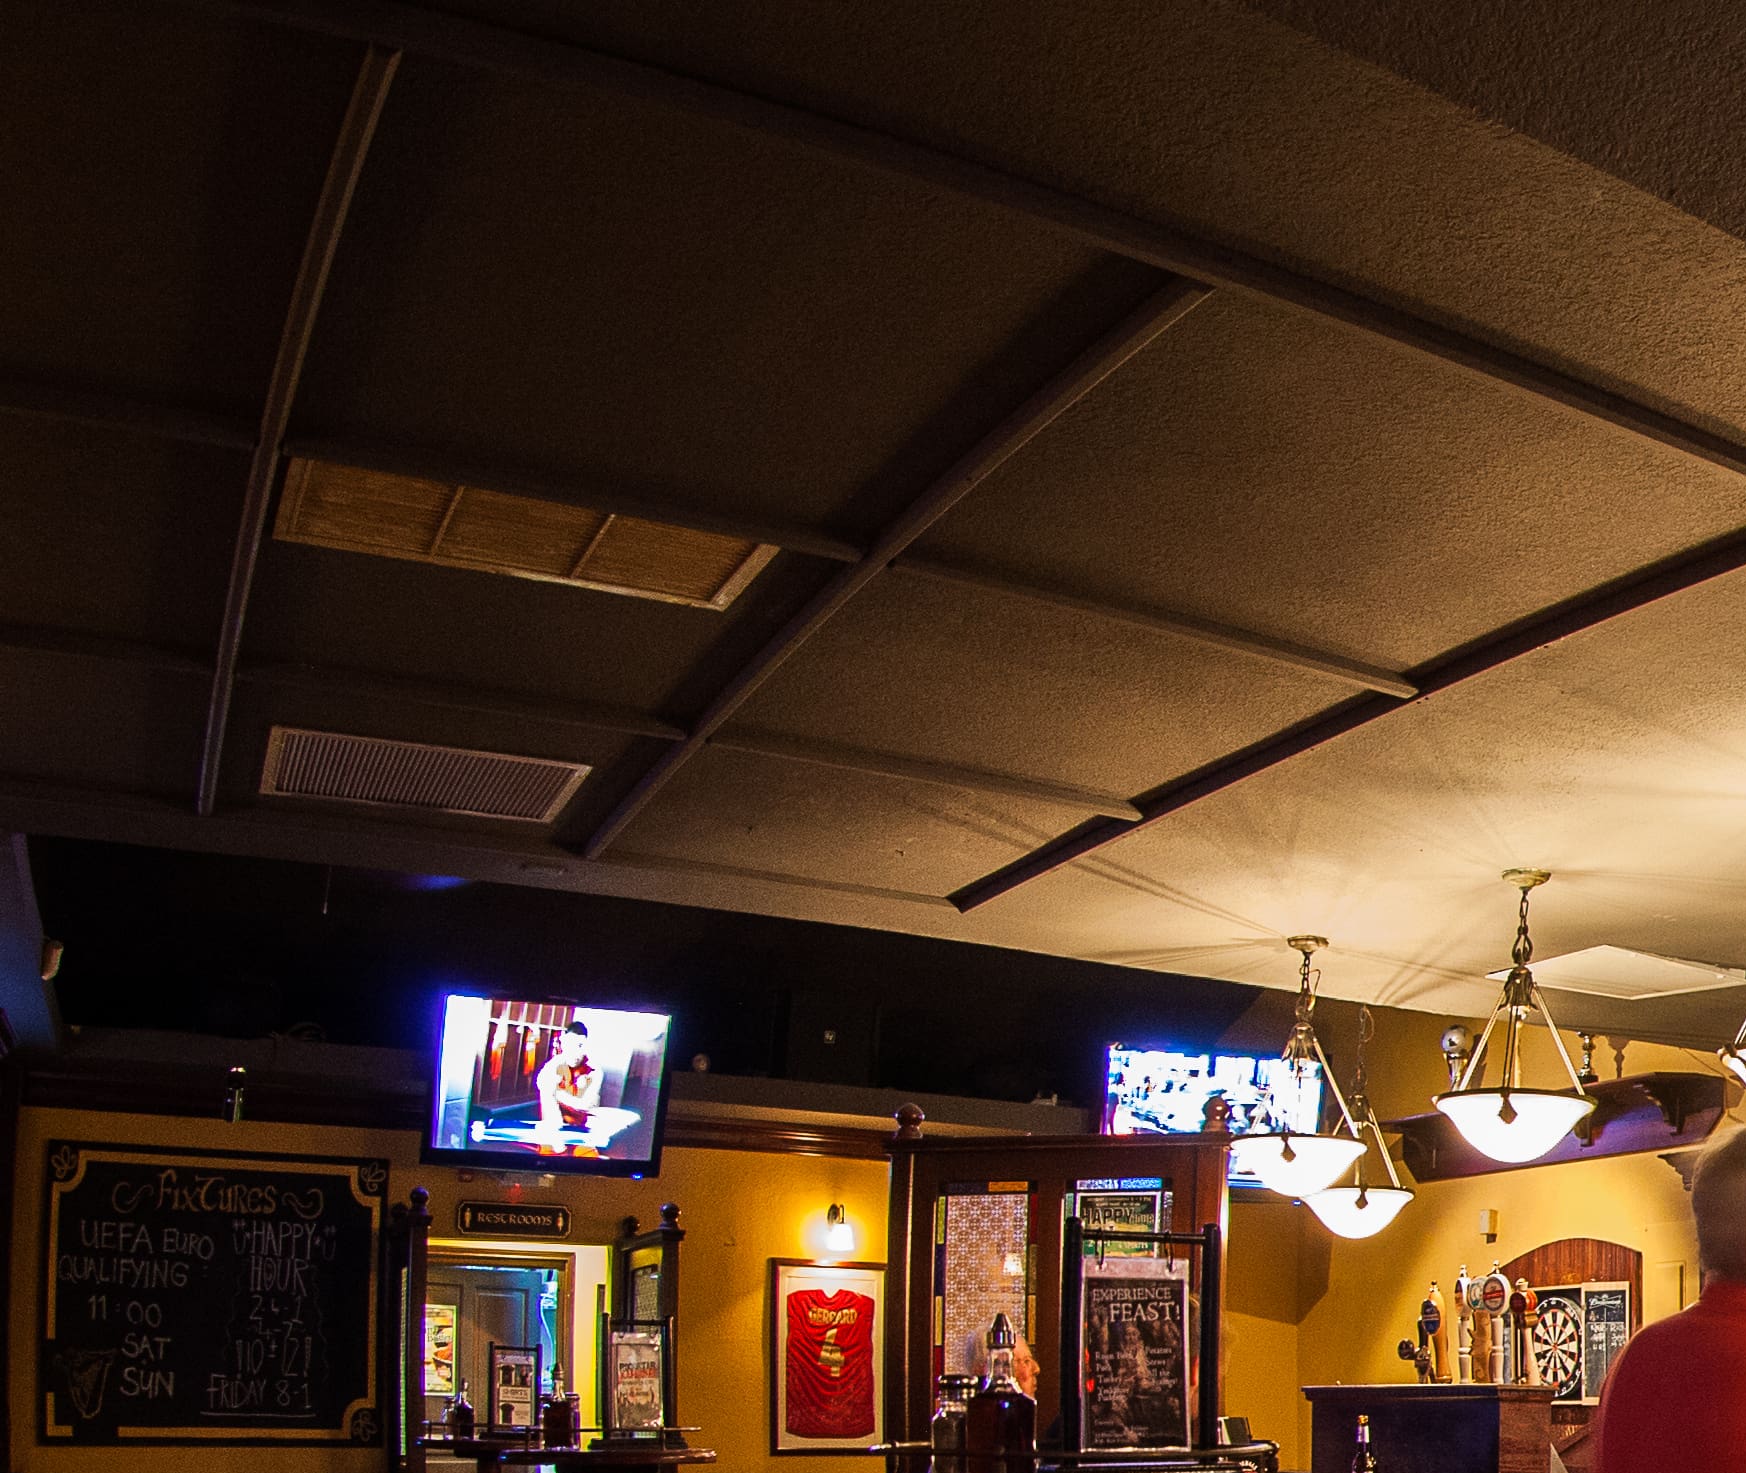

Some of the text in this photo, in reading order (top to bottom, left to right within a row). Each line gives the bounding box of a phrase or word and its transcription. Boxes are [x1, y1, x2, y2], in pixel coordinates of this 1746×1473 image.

[79, 1219, 216, 1262] UEFA EURO
[58, 1254, 190, 1289] QUALIFYING
[249, 1254, 310, 1297] HOUR
[1092, 1287, 1172, 1301] EXPERIENCE
[1110, 1301, 1181, 1323] FEAST!
[120, 1331, 172, 1362] SAT
[818, 1328, 845, 1377] 4
[118, 1366, 176, 1400] SUN
[205, 1372, 267, 1409] FRIDAY
